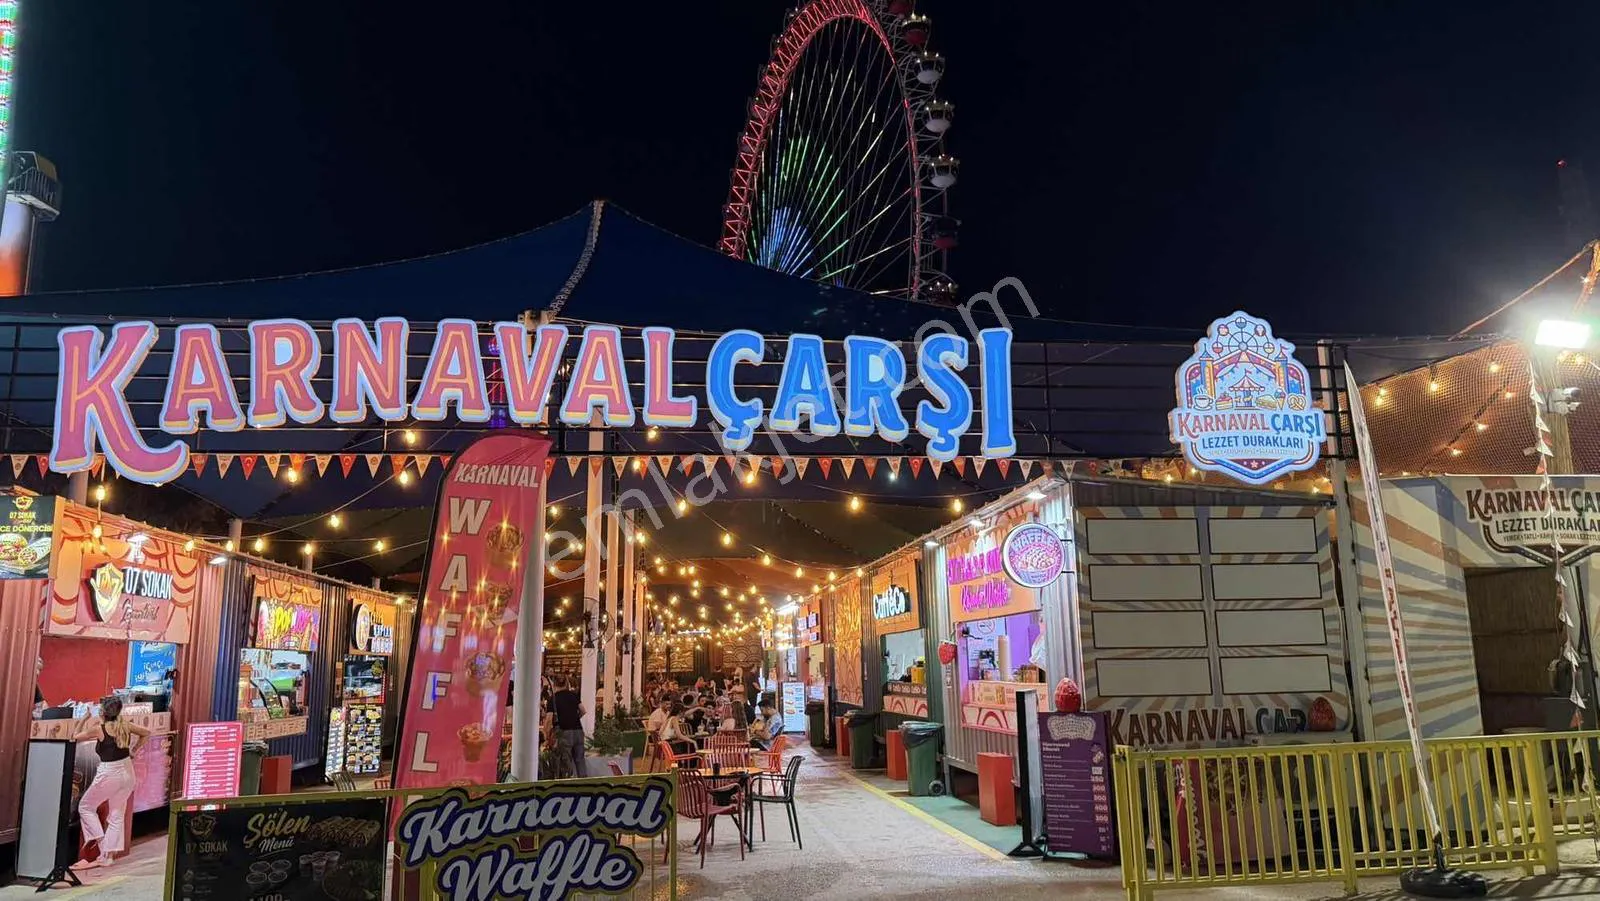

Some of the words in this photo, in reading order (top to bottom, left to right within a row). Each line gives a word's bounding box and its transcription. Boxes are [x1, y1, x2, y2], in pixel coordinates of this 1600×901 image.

[49, 316, 697, 486] KARNAVAL
[706, 327, 1017, 462] ÇARŞI
[1177, 412, 1270, 439] KARNAVAL
[1271, 412, 1321, 439] ÇARŞI
[1202, 436, 1240, 449] LEZZET
[1243, 435, 1304, 449] DURAKLARI
[453, 463, 539, 489] KARNAVAL
[1466, 489, 1570, 521] KARNAVAL
[1496, 517, 1537, 534] LEZZET
[1011, 533, 1055, 552] WAFFLE
[125, 567, 140, 595] 07
[141, 570, 173, 600] SOKAK
[408, 496, 492, 804] WAFFL
[1109, 707, 1254, 747] KARNAVAL
[243, 811, 311, 849] Şölen
[403, 789, 662, 863] Karnaval
[199, 840, 228, 853] SOKAK
[258, 837, 294, 853] Menü
[442, 833, 633, 901] Waffle
